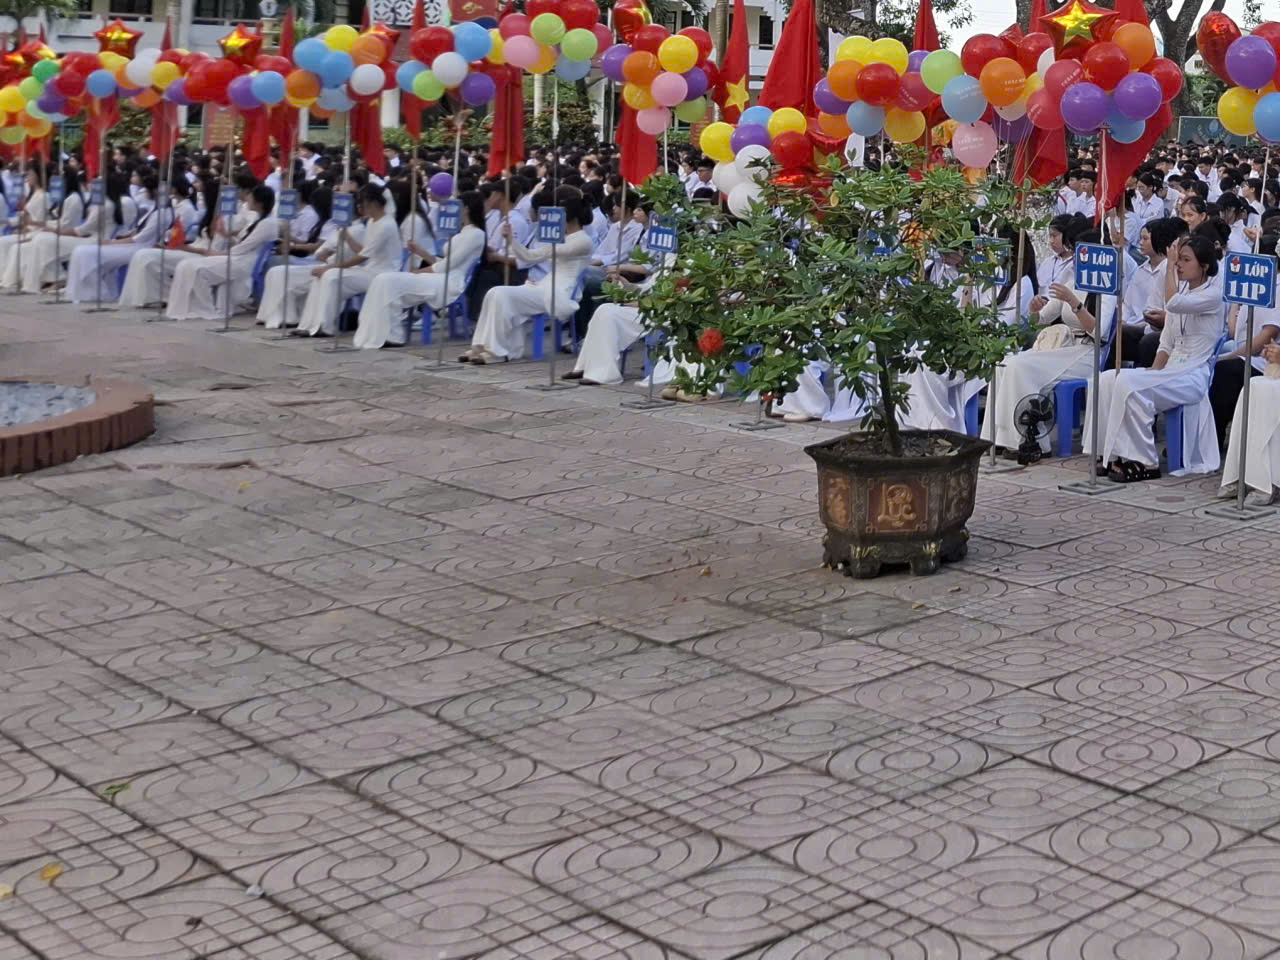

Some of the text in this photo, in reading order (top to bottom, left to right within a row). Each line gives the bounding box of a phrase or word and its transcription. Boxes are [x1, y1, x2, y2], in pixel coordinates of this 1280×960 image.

[540, 226, 560, 239] 11G
[1092, 250, 1114, 266] LỚP
[1244, 261, 1269, 278] LỚP
[1080, 269, 1113, 289] 11N
[1228, 280, 1266, 300] 11P
